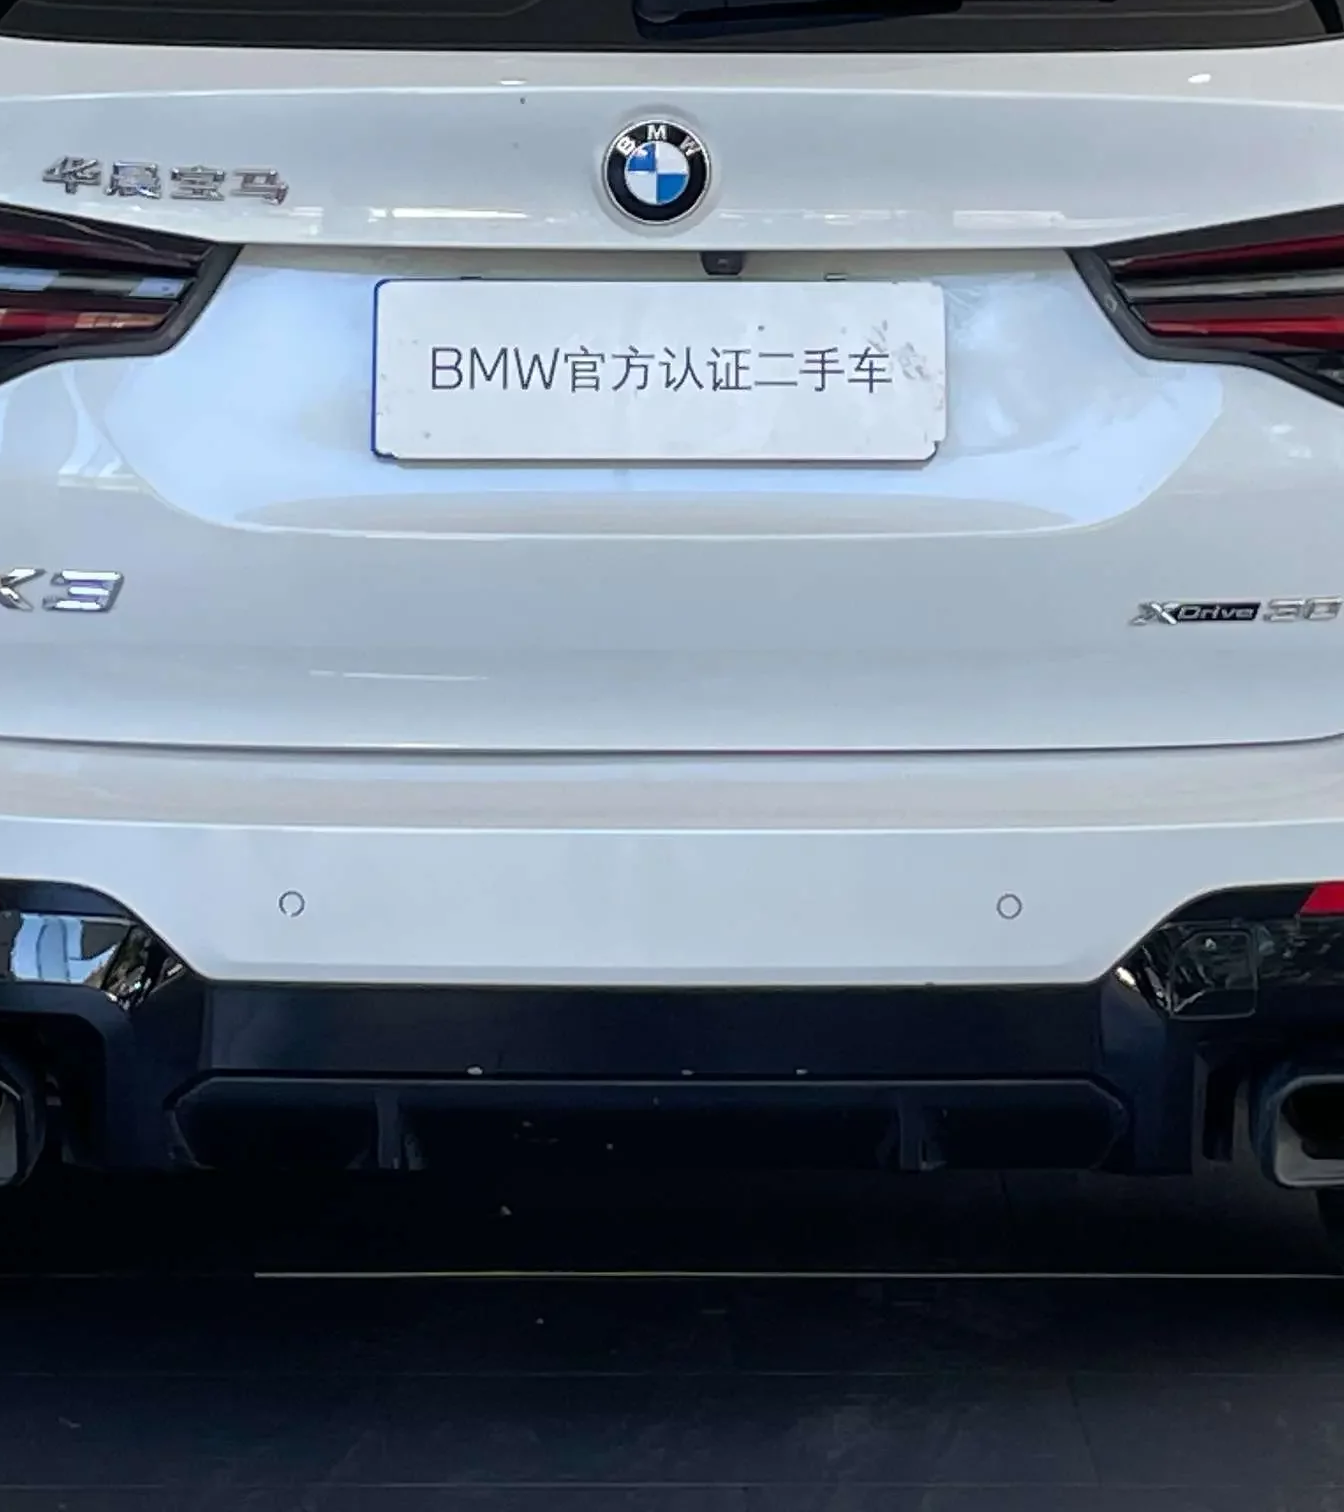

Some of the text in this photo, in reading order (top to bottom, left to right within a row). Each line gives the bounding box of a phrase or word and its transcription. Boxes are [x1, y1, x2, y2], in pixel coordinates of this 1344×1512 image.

[616, 124, 702, 156] BMW
[42, 155, 290, 205] 华晨宝马
[430, 344, 893, 393] BMW官方认证二手车
